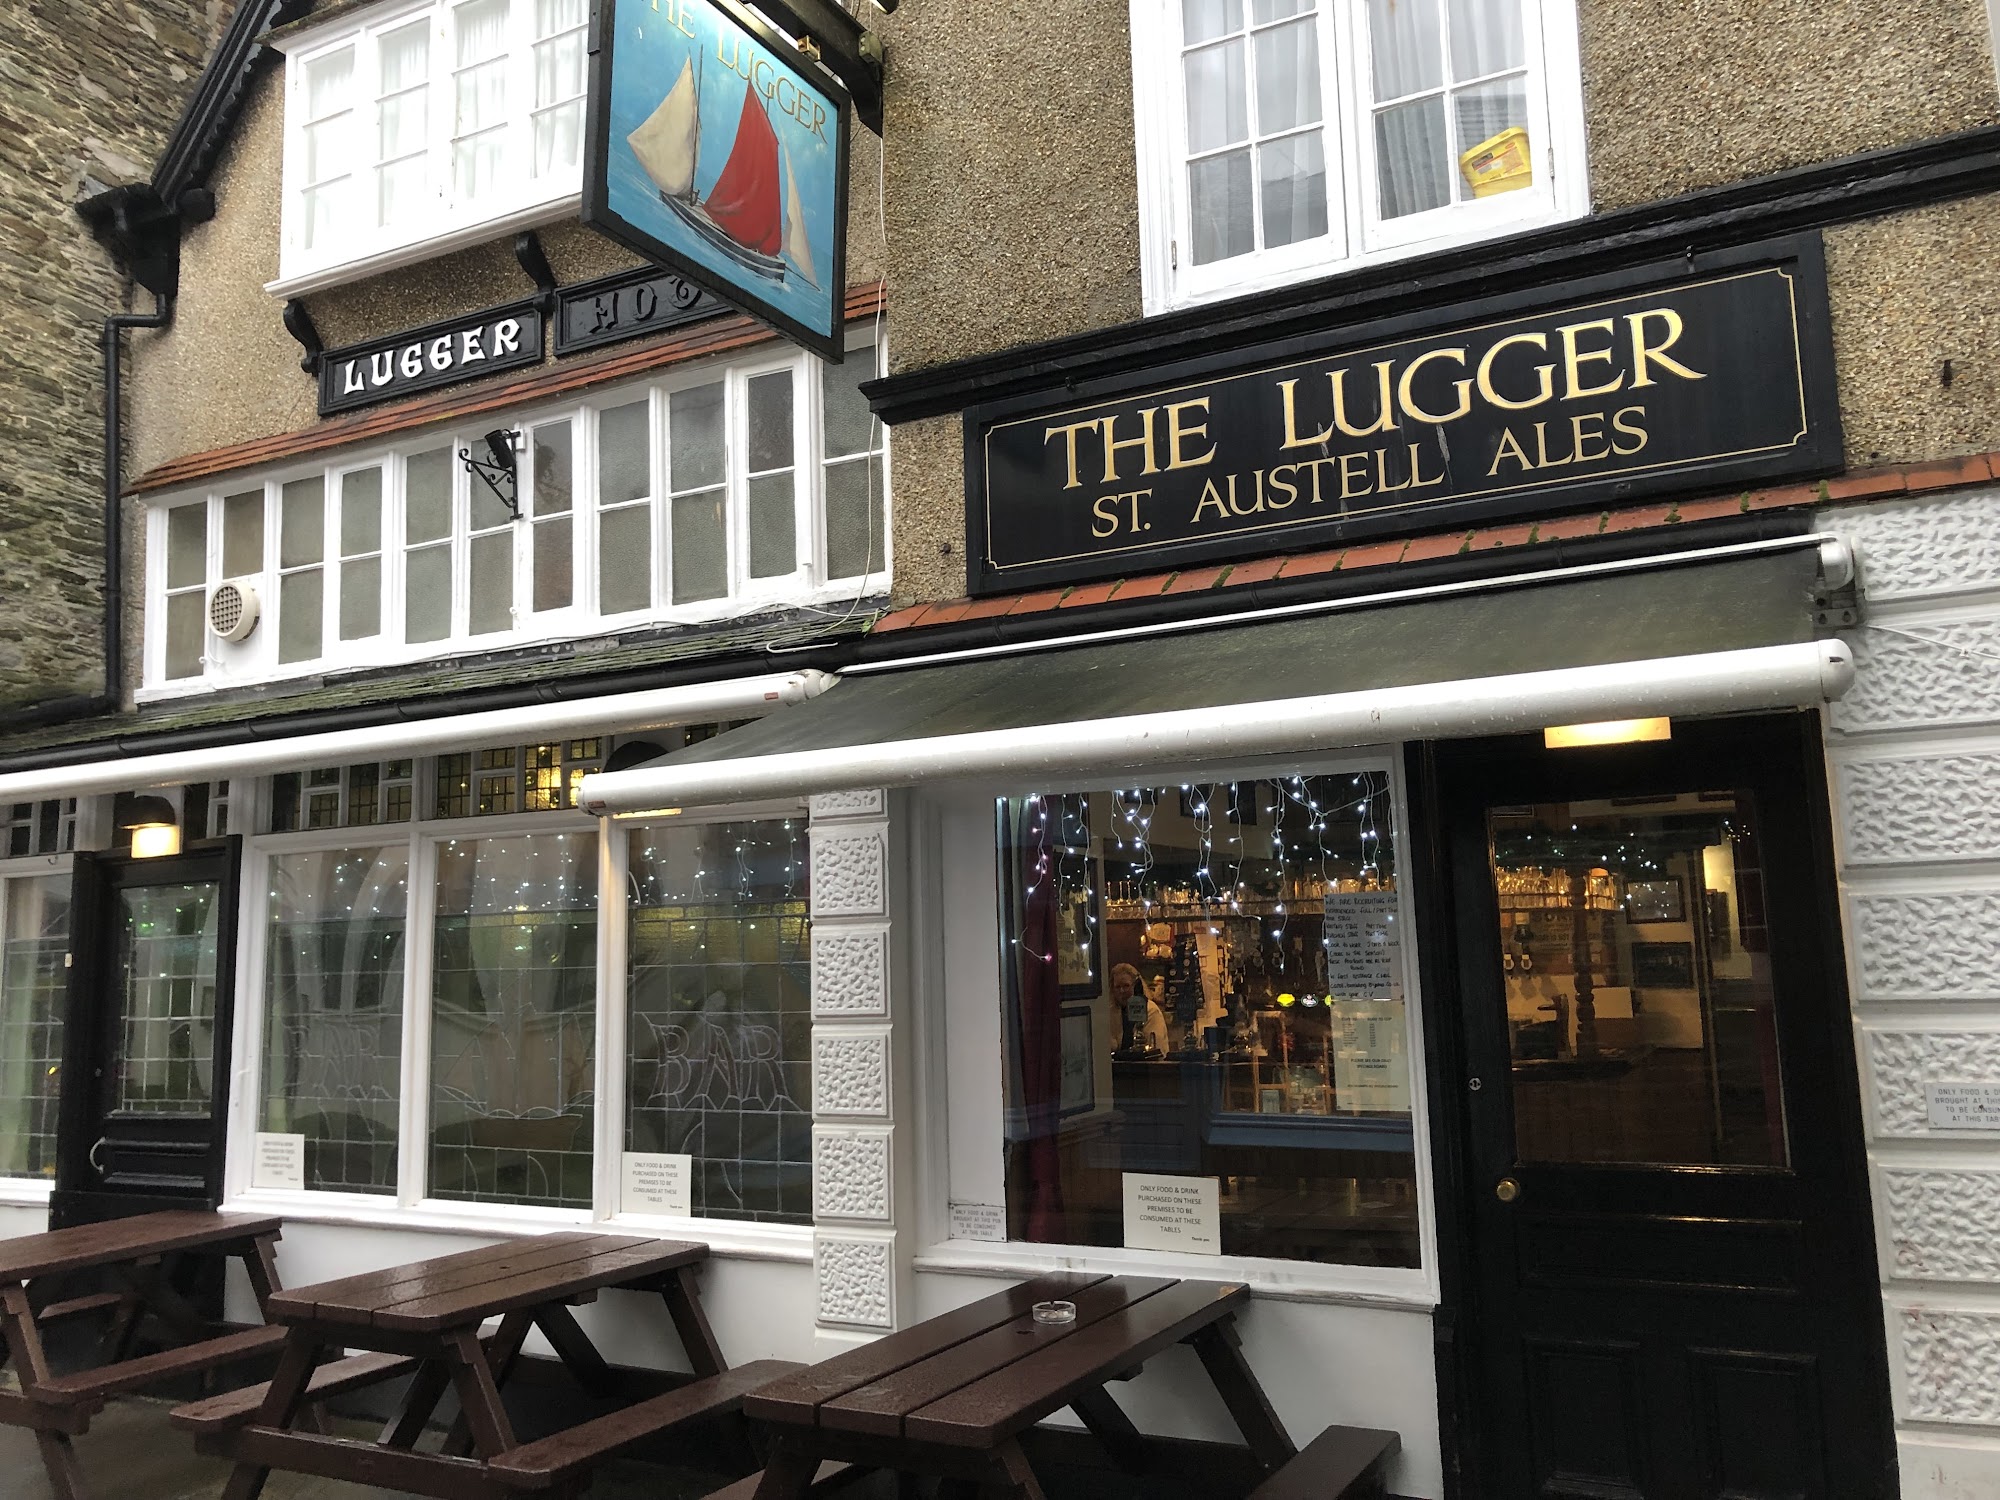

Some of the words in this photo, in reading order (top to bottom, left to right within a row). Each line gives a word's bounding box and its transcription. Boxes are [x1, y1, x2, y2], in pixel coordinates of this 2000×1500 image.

[650, 0, 697, 40] HE
[716, 26, 828, 145] LUGGER
[343, 318, 521, 395] LUGGER
[1044, 396, 1217, 491] THE
[1276, 307, 1707, 451] LUGGER
[1091, 488, 1152, 538] ST.
[1191, 443, 1447, 525] AUSTELL
[1487, 405, 1649, 476] ALES
[641, 1012, 805, 1112] BAR
[1138, 1195, 1172, 1203] PURCHASED
[1140, 1215, 1173, 1223] CONSUMED
[1147, 1205, 1175, 1213] PREMISES
